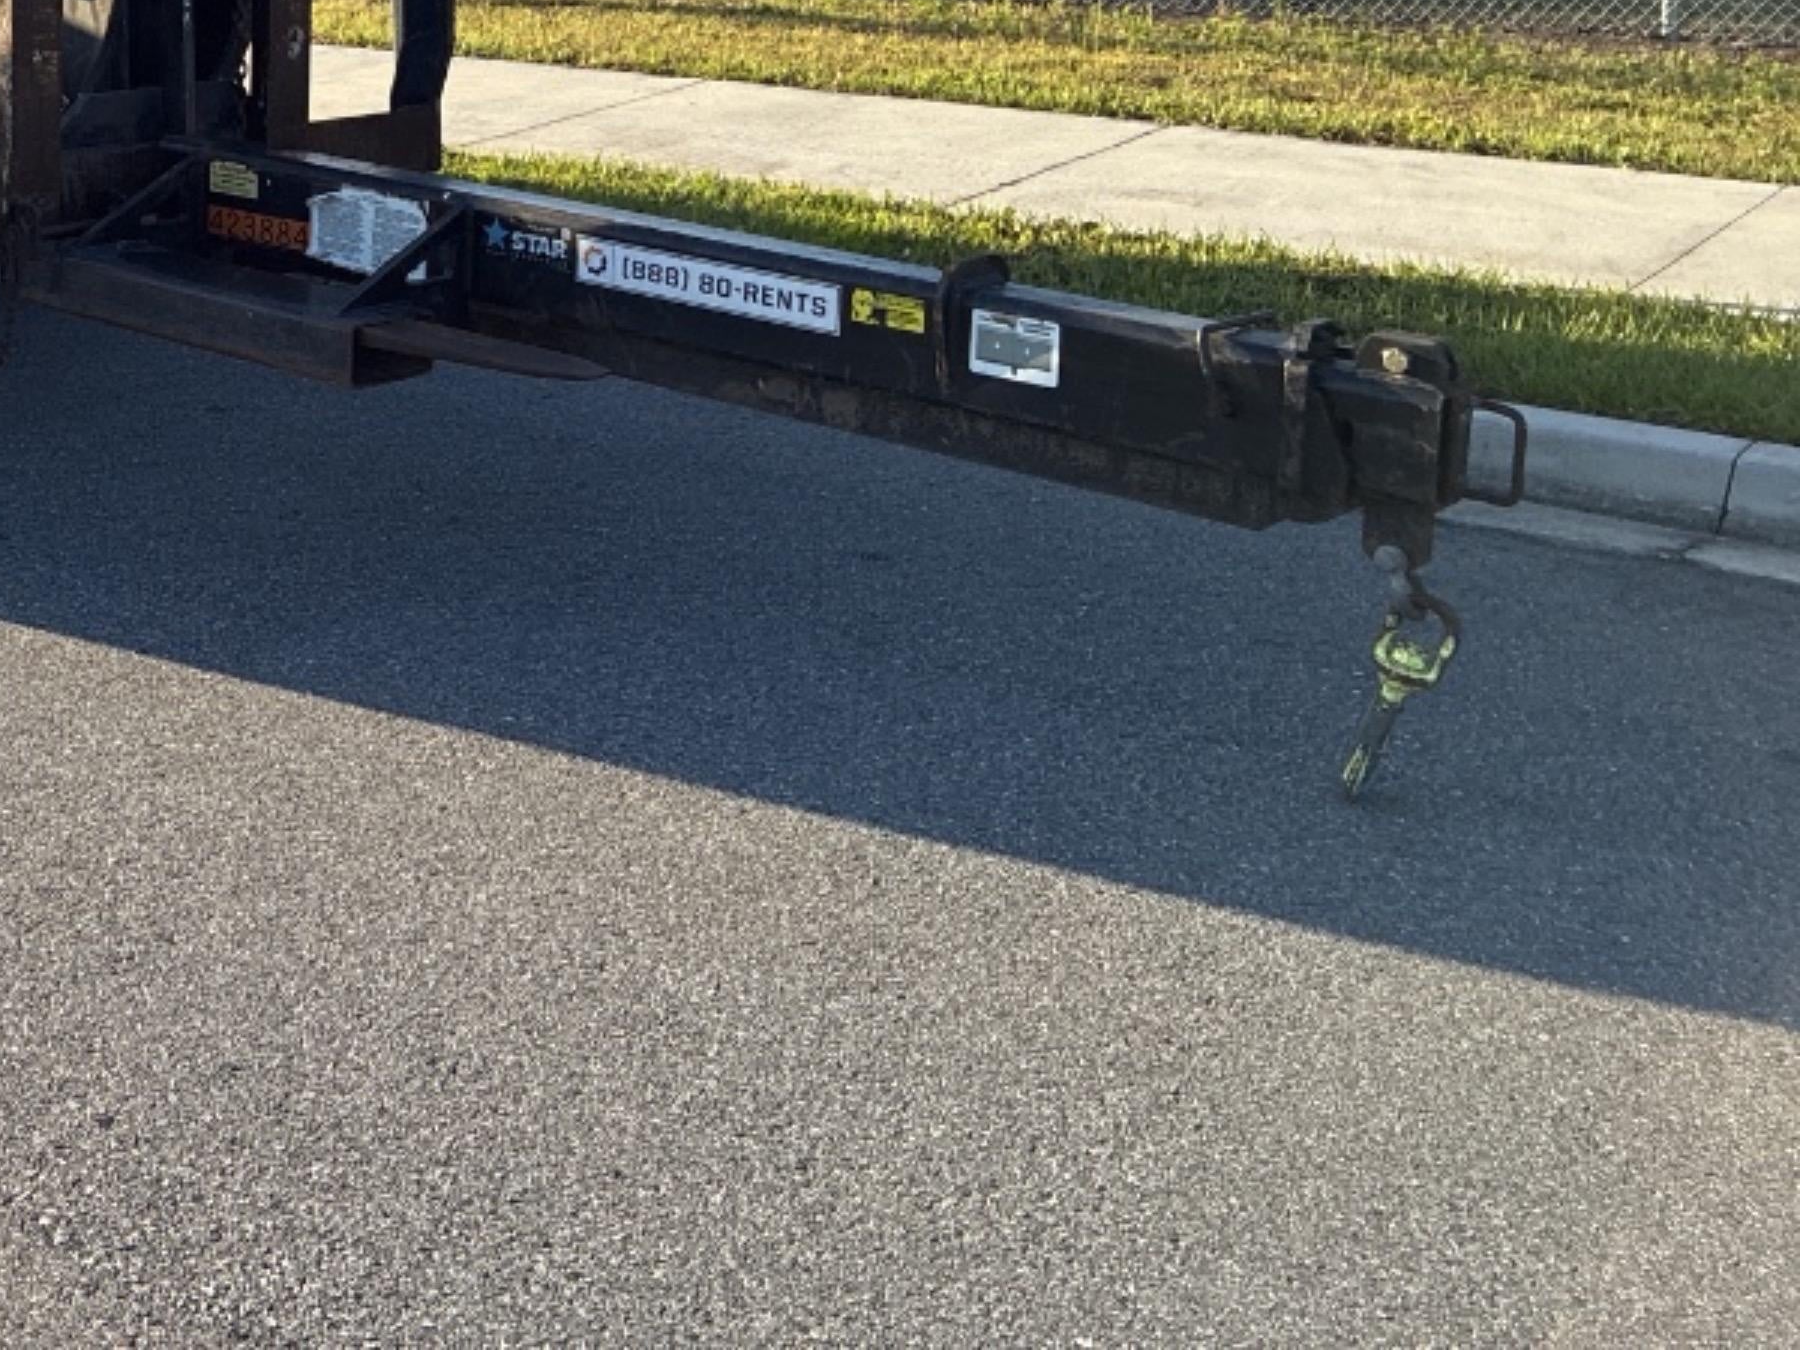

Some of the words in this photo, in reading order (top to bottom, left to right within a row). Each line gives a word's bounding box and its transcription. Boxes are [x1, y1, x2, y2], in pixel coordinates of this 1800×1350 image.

[511, 230, 569, 259] STAR
[623, 256, 690, 292] (888)
[698, 273, 828, 317] 80-RENTS
